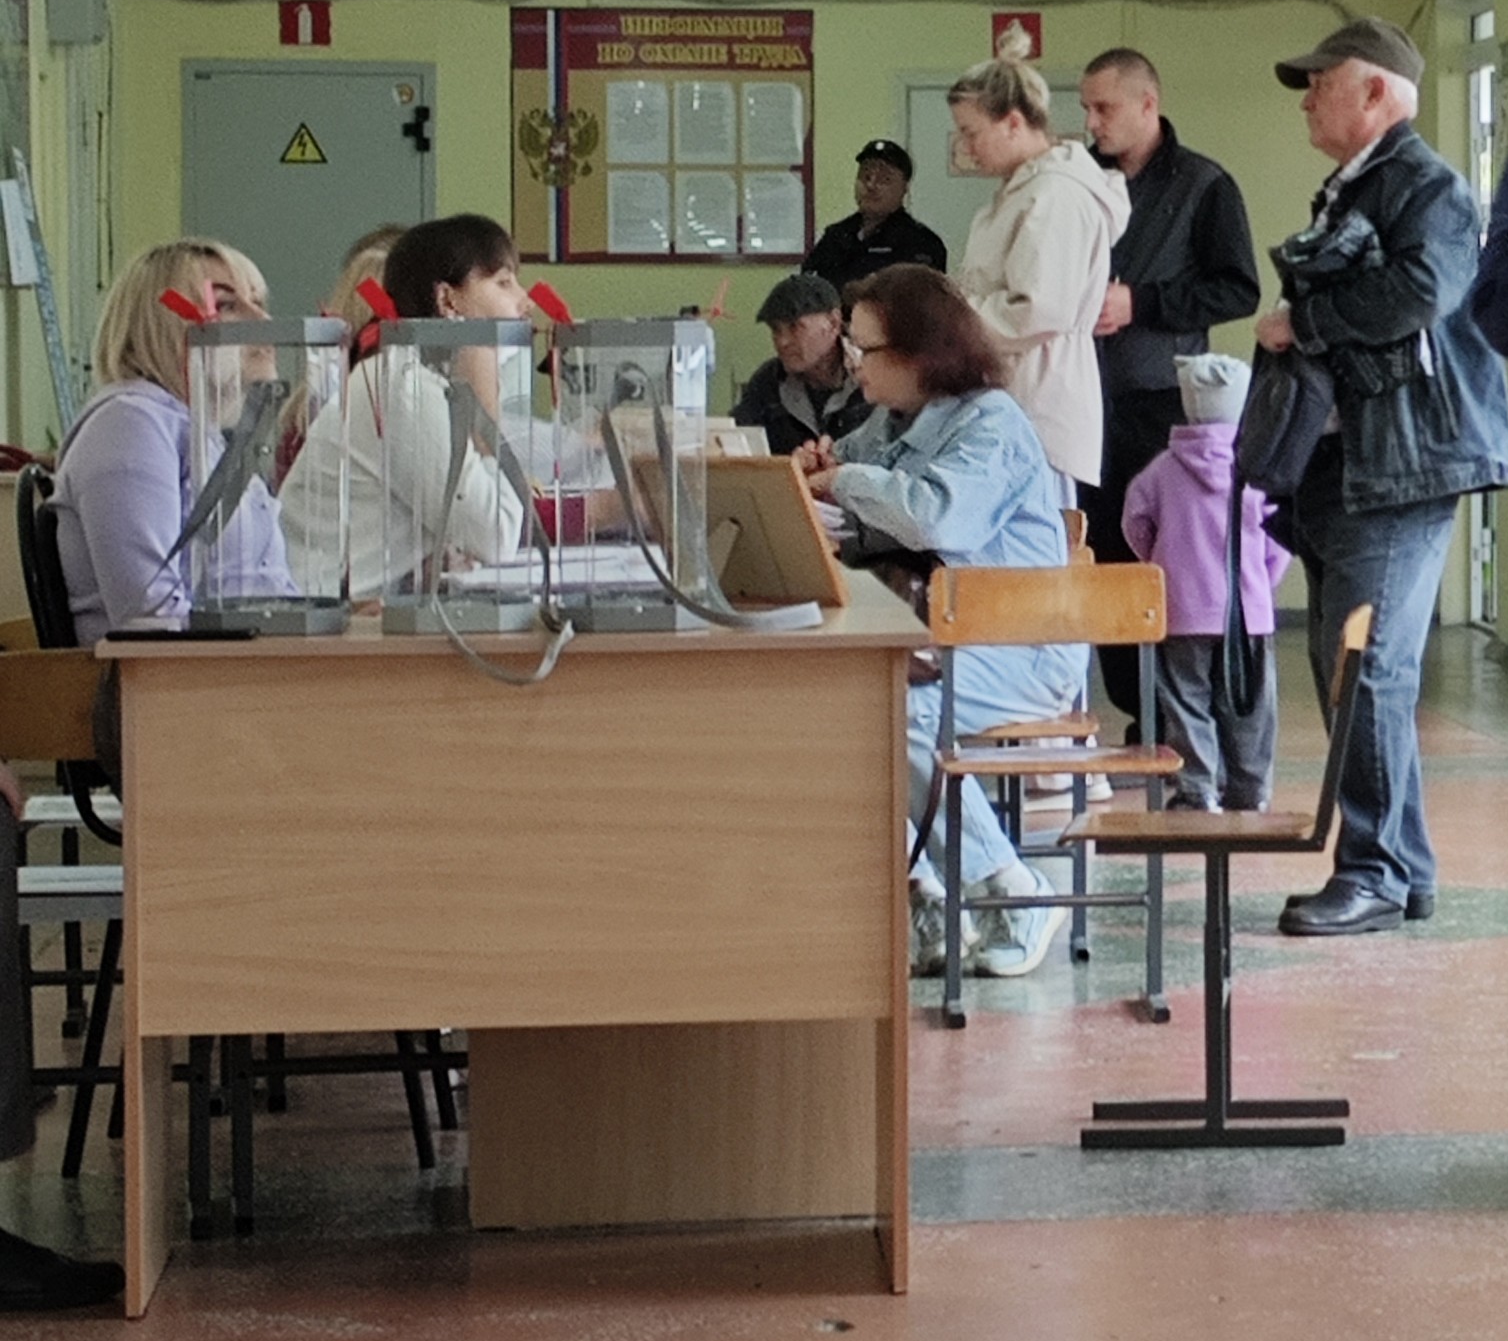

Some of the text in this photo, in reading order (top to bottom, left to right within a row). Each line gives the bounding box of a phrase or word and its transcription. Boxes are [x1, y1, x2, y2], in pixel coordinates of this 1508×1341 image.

[620, 15, 784, 40] ИНФОРМАЦИЯ
[597, 42, 807, 67] ПО ОХРАНЕ ТРУДА
